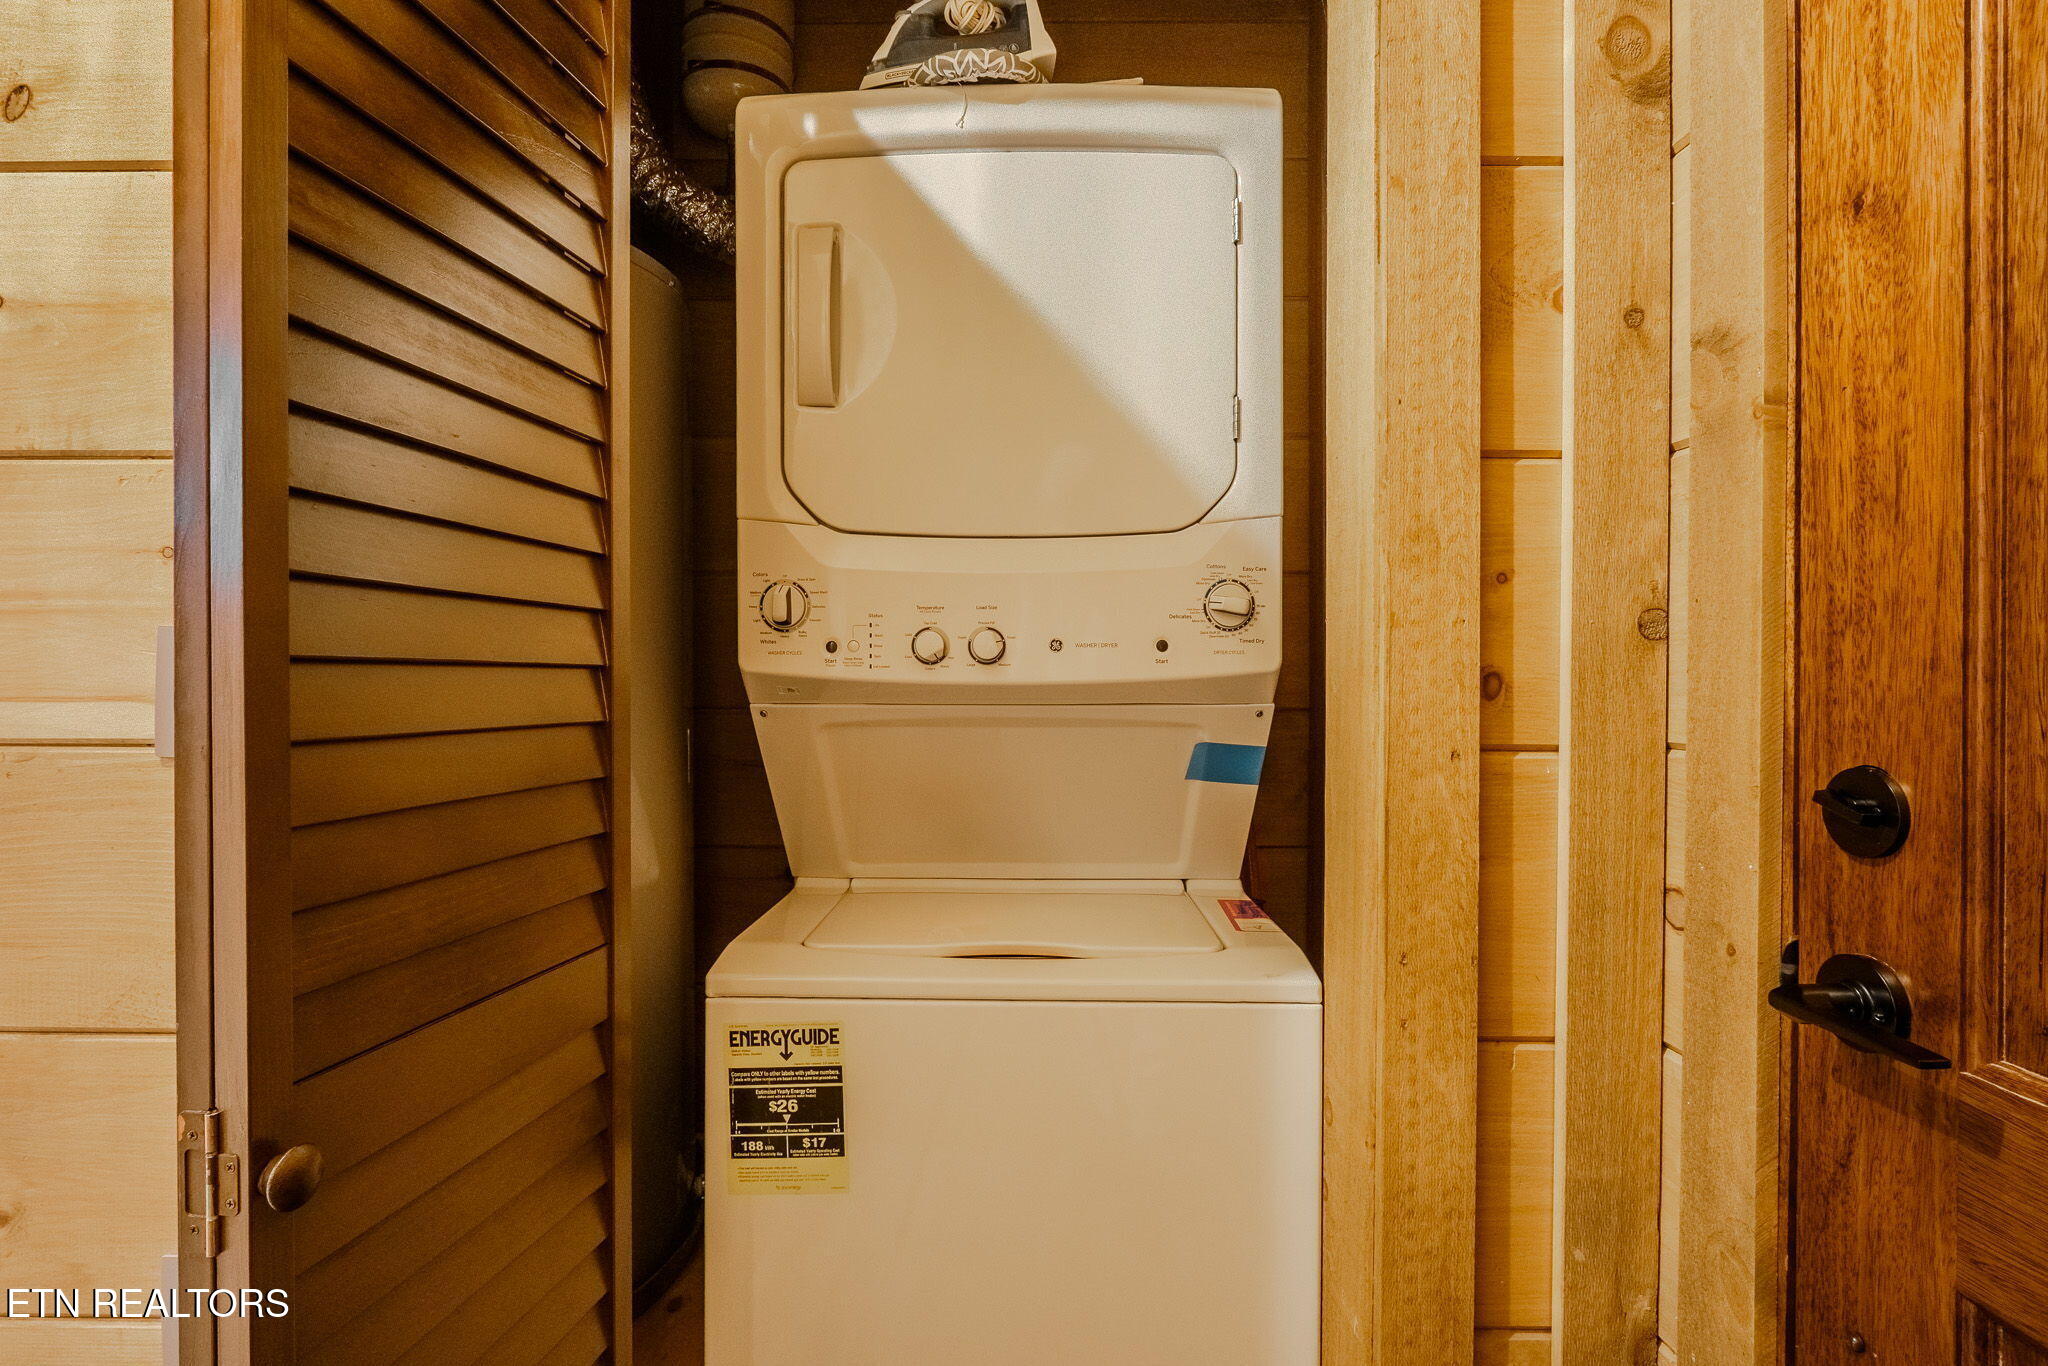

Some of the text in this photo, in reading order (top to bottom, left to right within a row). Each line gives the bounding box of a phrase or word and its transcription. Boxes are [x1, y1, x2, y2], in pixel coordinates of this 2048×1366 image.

[729, 1028, 840, 1048] ENERGYGUIDE
[769, 1100, 798, 1113] $26
[741, 1141, 763, 1151] 188
[803, 1137, 826, 1148] $17
